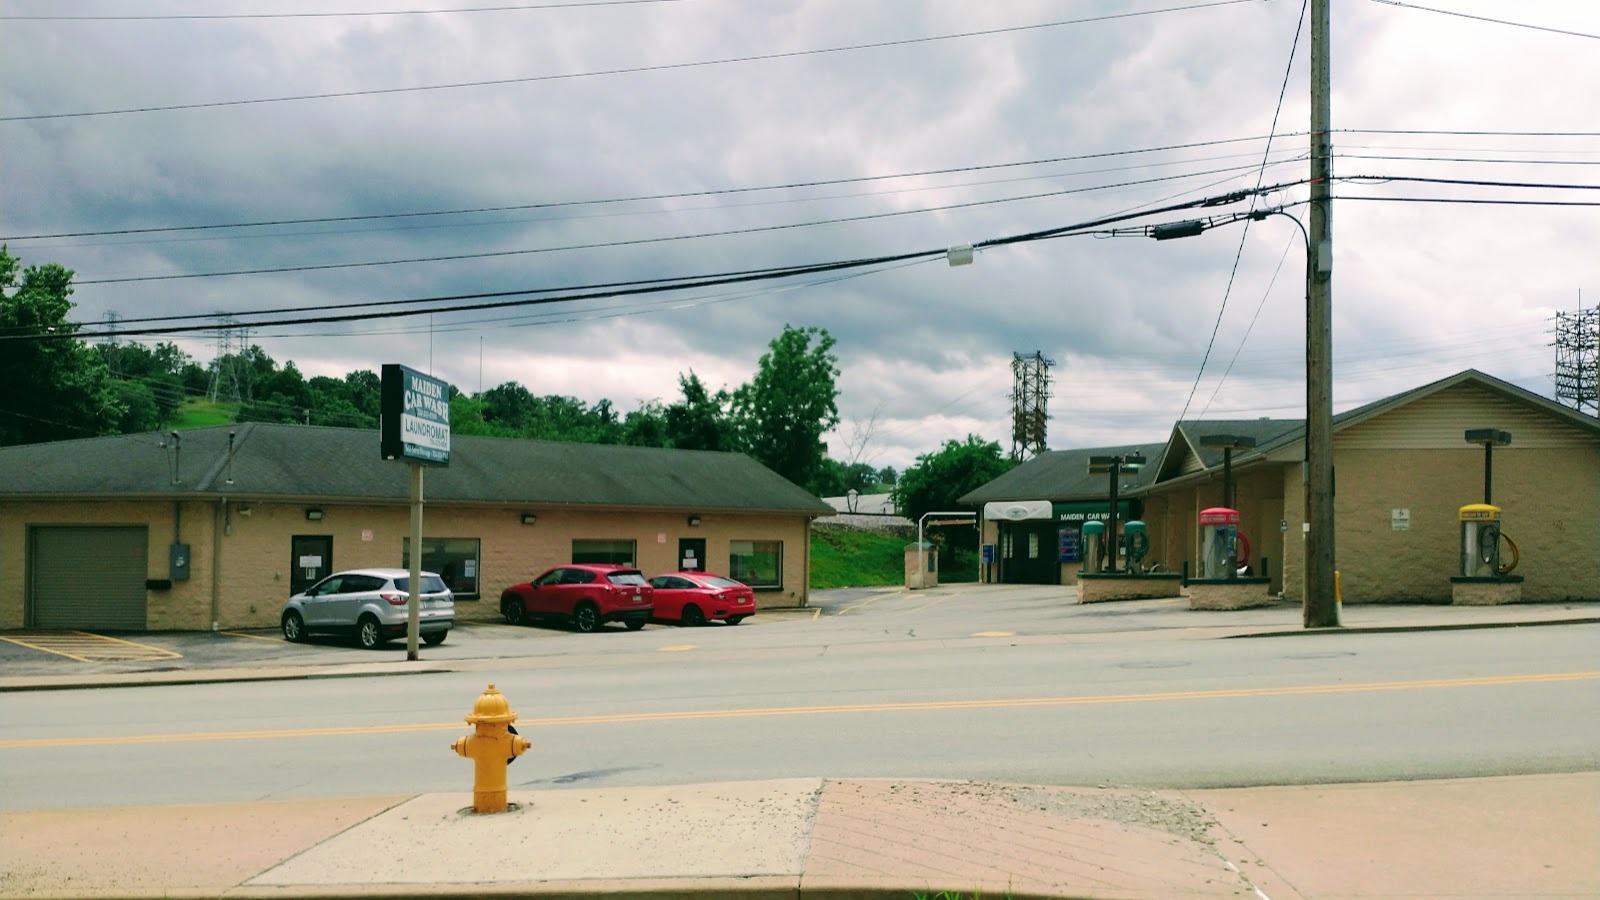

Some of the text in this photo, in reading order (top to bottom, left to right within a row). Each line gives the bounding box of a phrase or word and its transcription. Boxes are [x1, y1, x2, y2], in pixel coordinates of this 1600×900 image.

[411, 376, 443, 399] MAIDEN
[404, 390, 423, 410] CAR
[423, 395, 448, 423] WASH
[405, 418, 448, 442] LAUNDROMAT
[1060, 513, 1085, 521] MAIDEN
[1087, 512, 1100, 520] CAR
